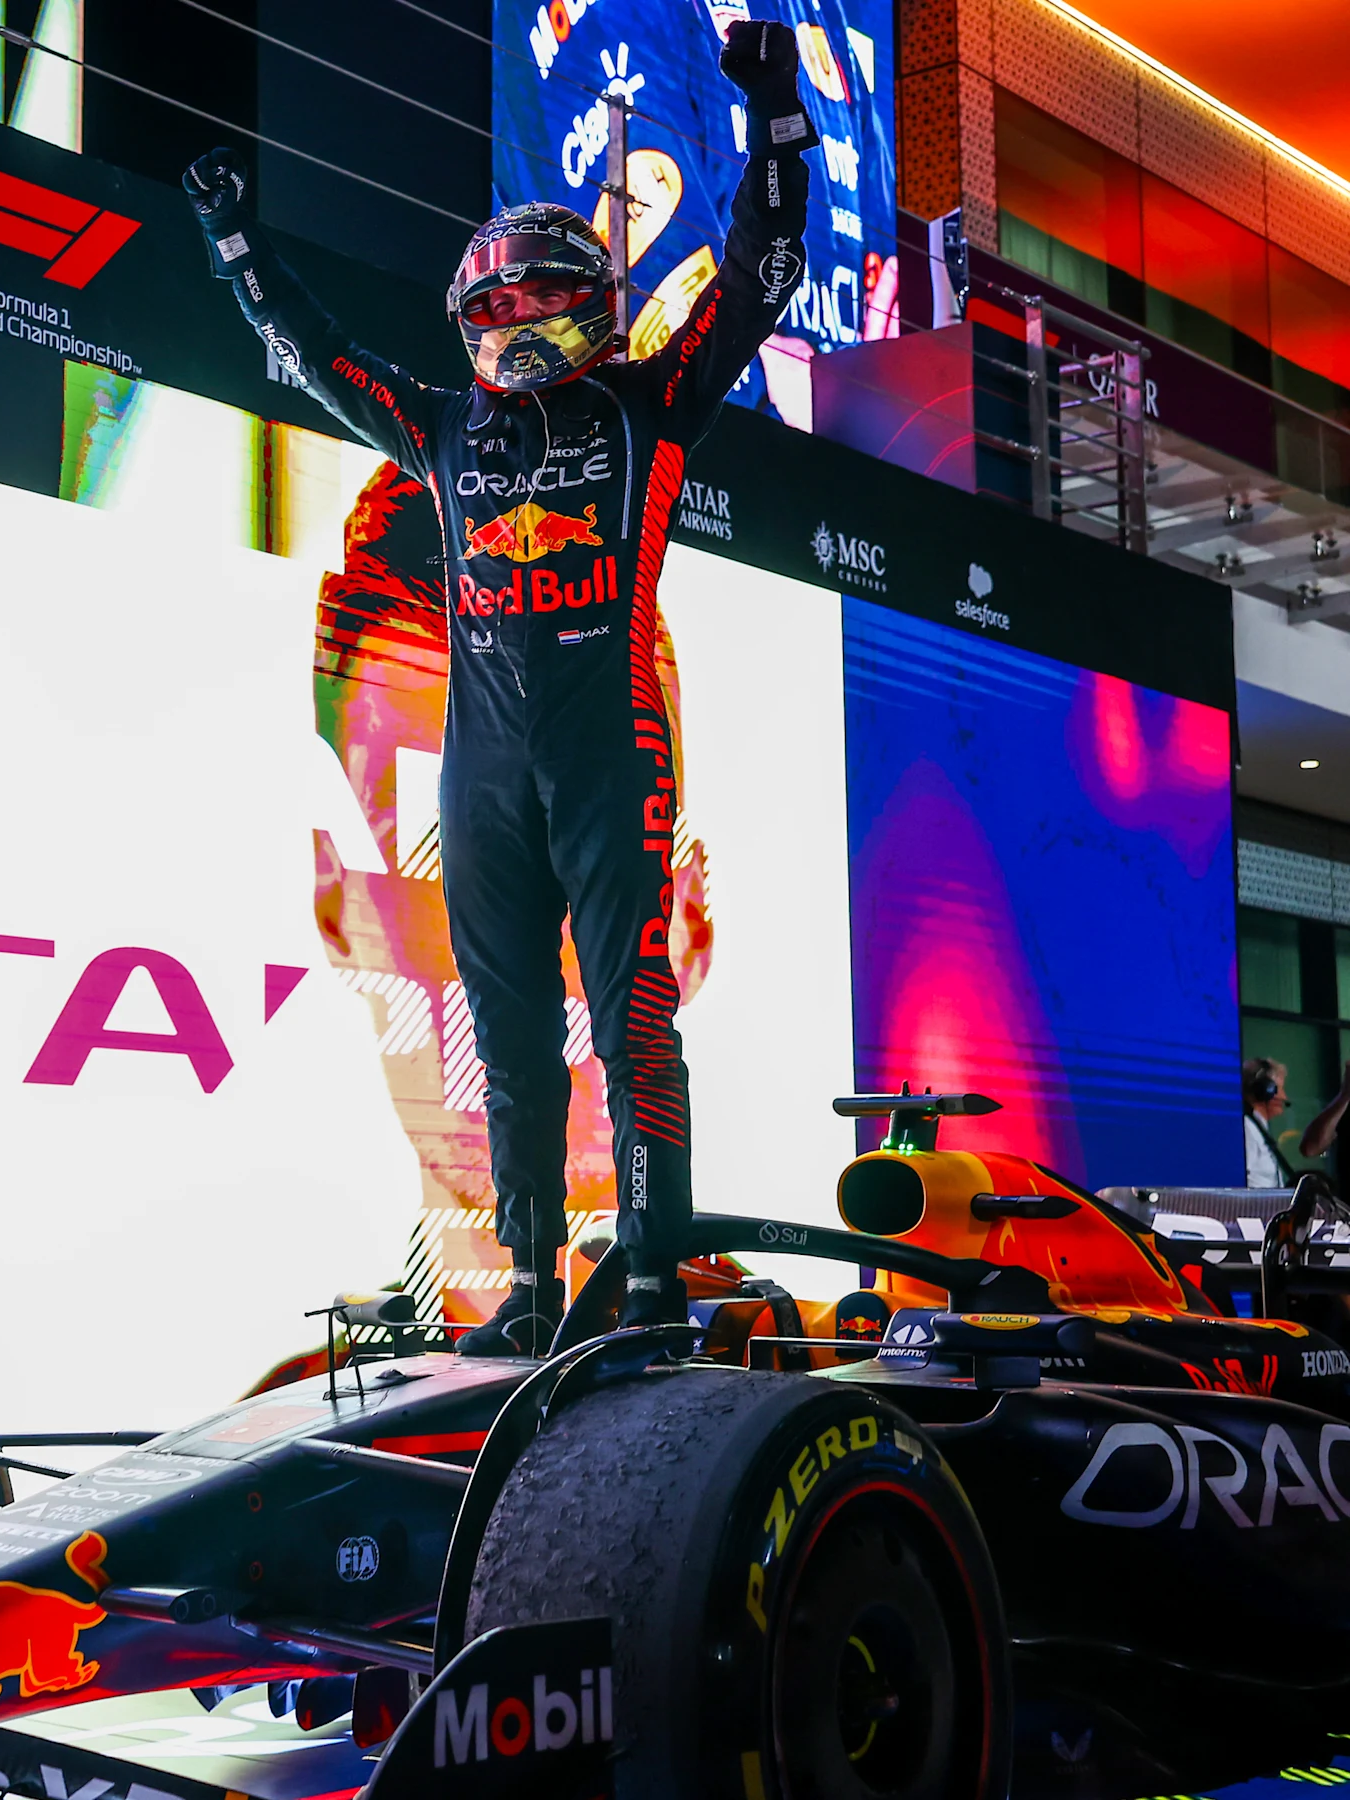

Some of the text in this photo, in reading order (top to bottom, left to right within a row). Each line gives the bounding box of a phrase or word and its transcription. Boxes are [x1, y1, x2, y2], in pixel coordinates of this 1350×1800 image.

[767, 159, 781, 208] sparco
[474, 223, 563, 253] ORACLE
[60, 308, 72, 330] 1
[332, 356, 369, 389] GIVES
[368, 379, 396, 409] YOU
[512, 366, 550, 382] SPORTS
[456, 453, 612, 497] ORACLE
[679, 479, 732, 520] ATAR
[679, 509, 733, 541] AIRWAYS
[837, 532, 886, 577] MSC
[457, 555, 619, 617] Red Bull
[955, 598, 1010, 630] salesforce
[580, 625, 610, 639] MAX
[632, 1145, 647, 1210] sparco
[780, 1227, 808, 1246] Sui
[981, 1315, 1030, 1324] RAUCH
[1301, 1350, 1350, 1378] HONDA
[51, 1504, 120, 1517] ARCTIC
[747, 1562, 767, 1634] P
[764, 1416, 879, 1557] ZERO
[435, 1666, 613, 1768] Mobil
